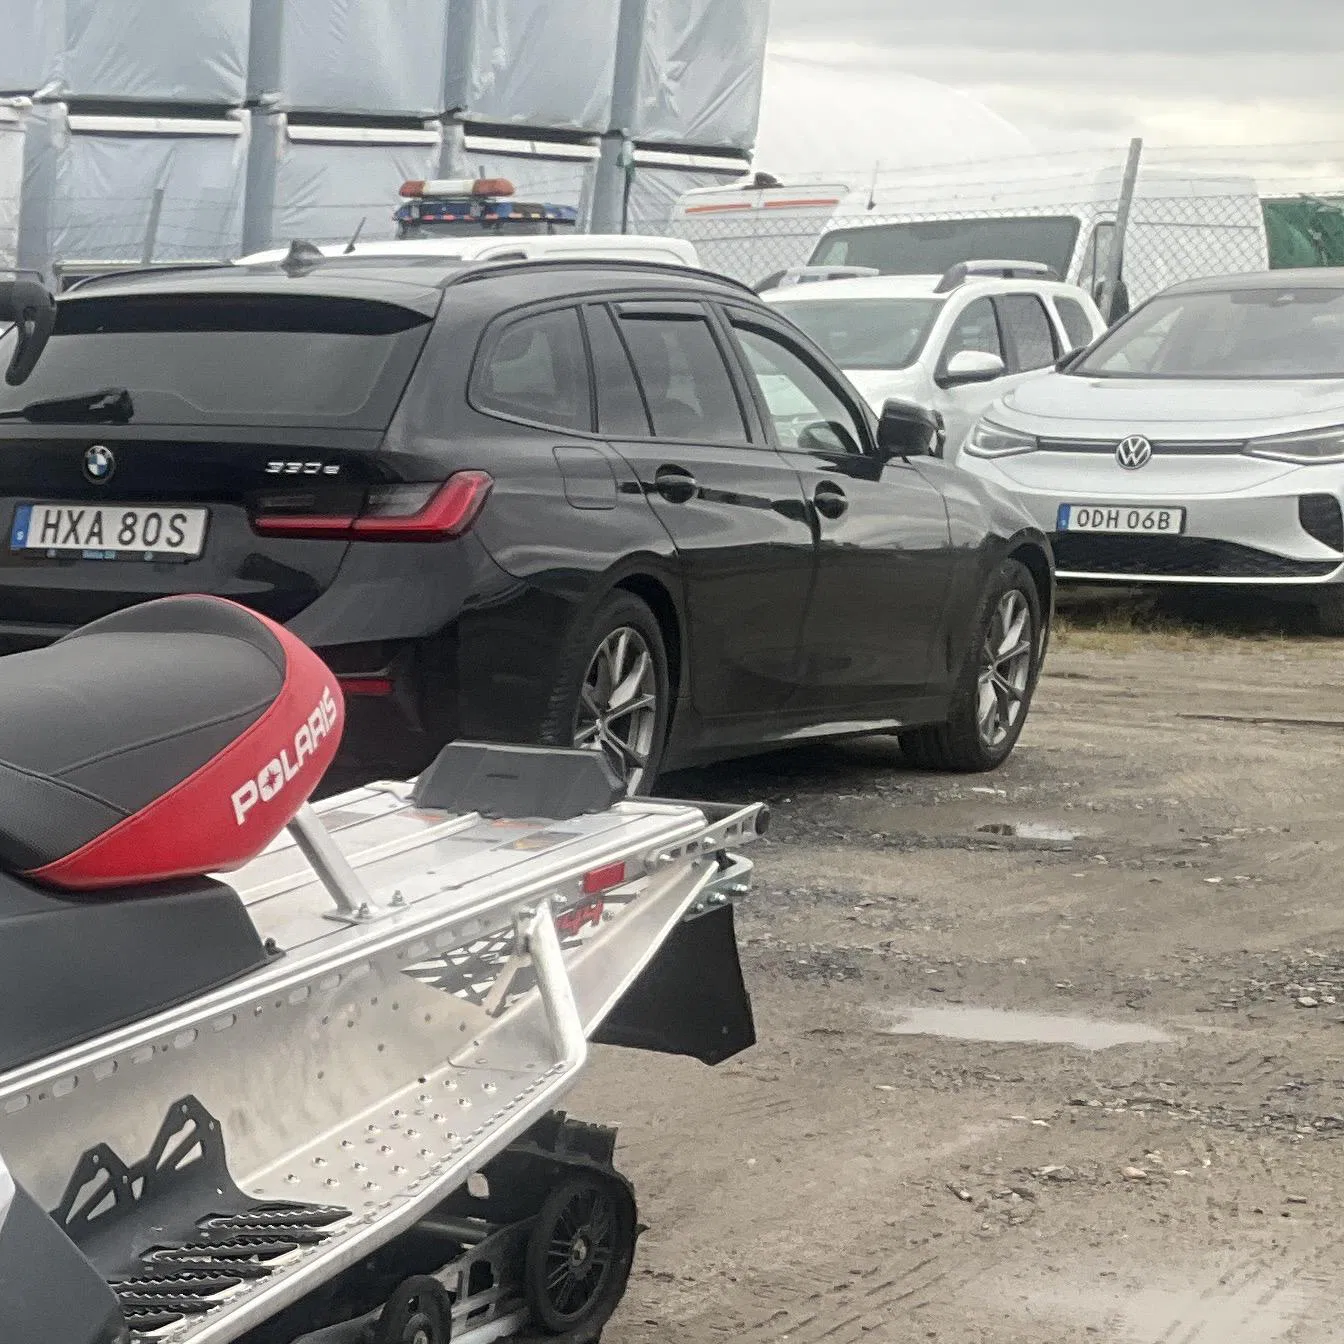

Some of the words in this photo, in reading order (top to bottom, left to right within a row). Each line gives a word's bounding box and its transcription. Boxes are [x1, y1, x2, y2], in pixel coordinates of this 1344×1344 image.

[40, 509, 105, 545] HXA
[118, 511, 187, 548] 80S
[1077, 509, 1119, 529] ODH
[1127, 510, 1171, 530] 06B
[231, 685, 337, 826] POLARIS
